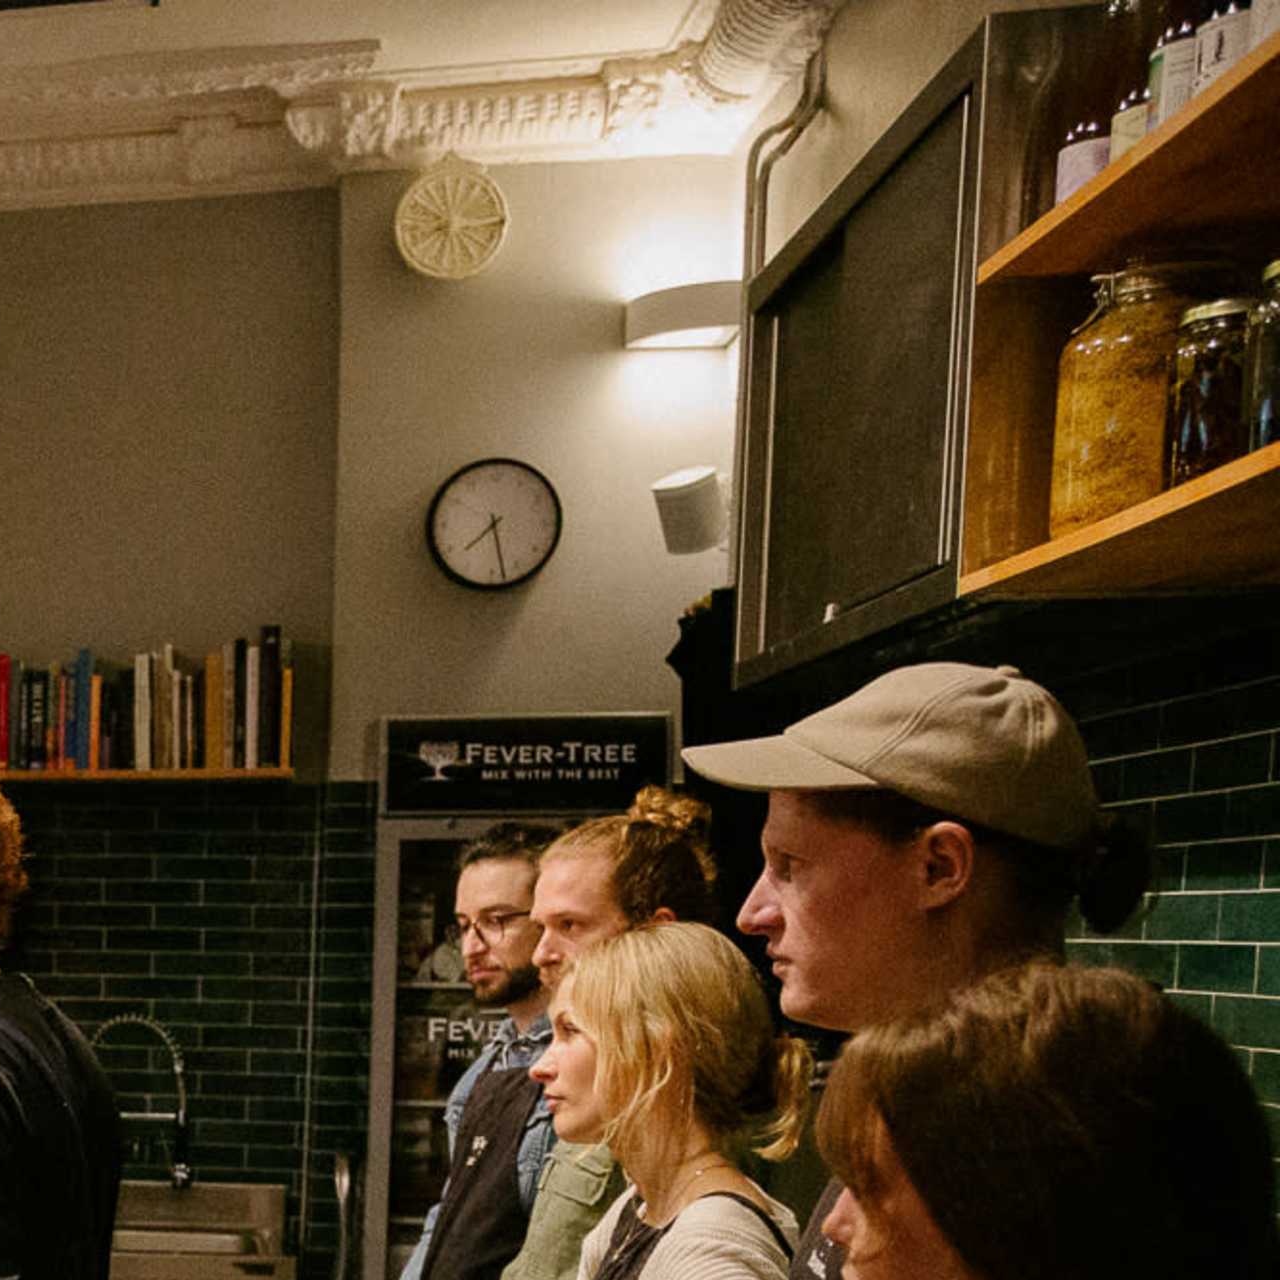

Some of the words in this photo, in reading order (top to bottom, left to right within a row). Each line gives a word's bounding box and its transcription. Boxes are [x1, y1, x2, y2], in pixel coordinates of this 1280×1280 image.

[465, 742, 637, 765] FEVER-TREE
[481, 768, 508, 781] MIX
[515, 768, 552, 781] WITH
[557, 768, 582, 781] THE
[588, 768, 620, 781] BEST
